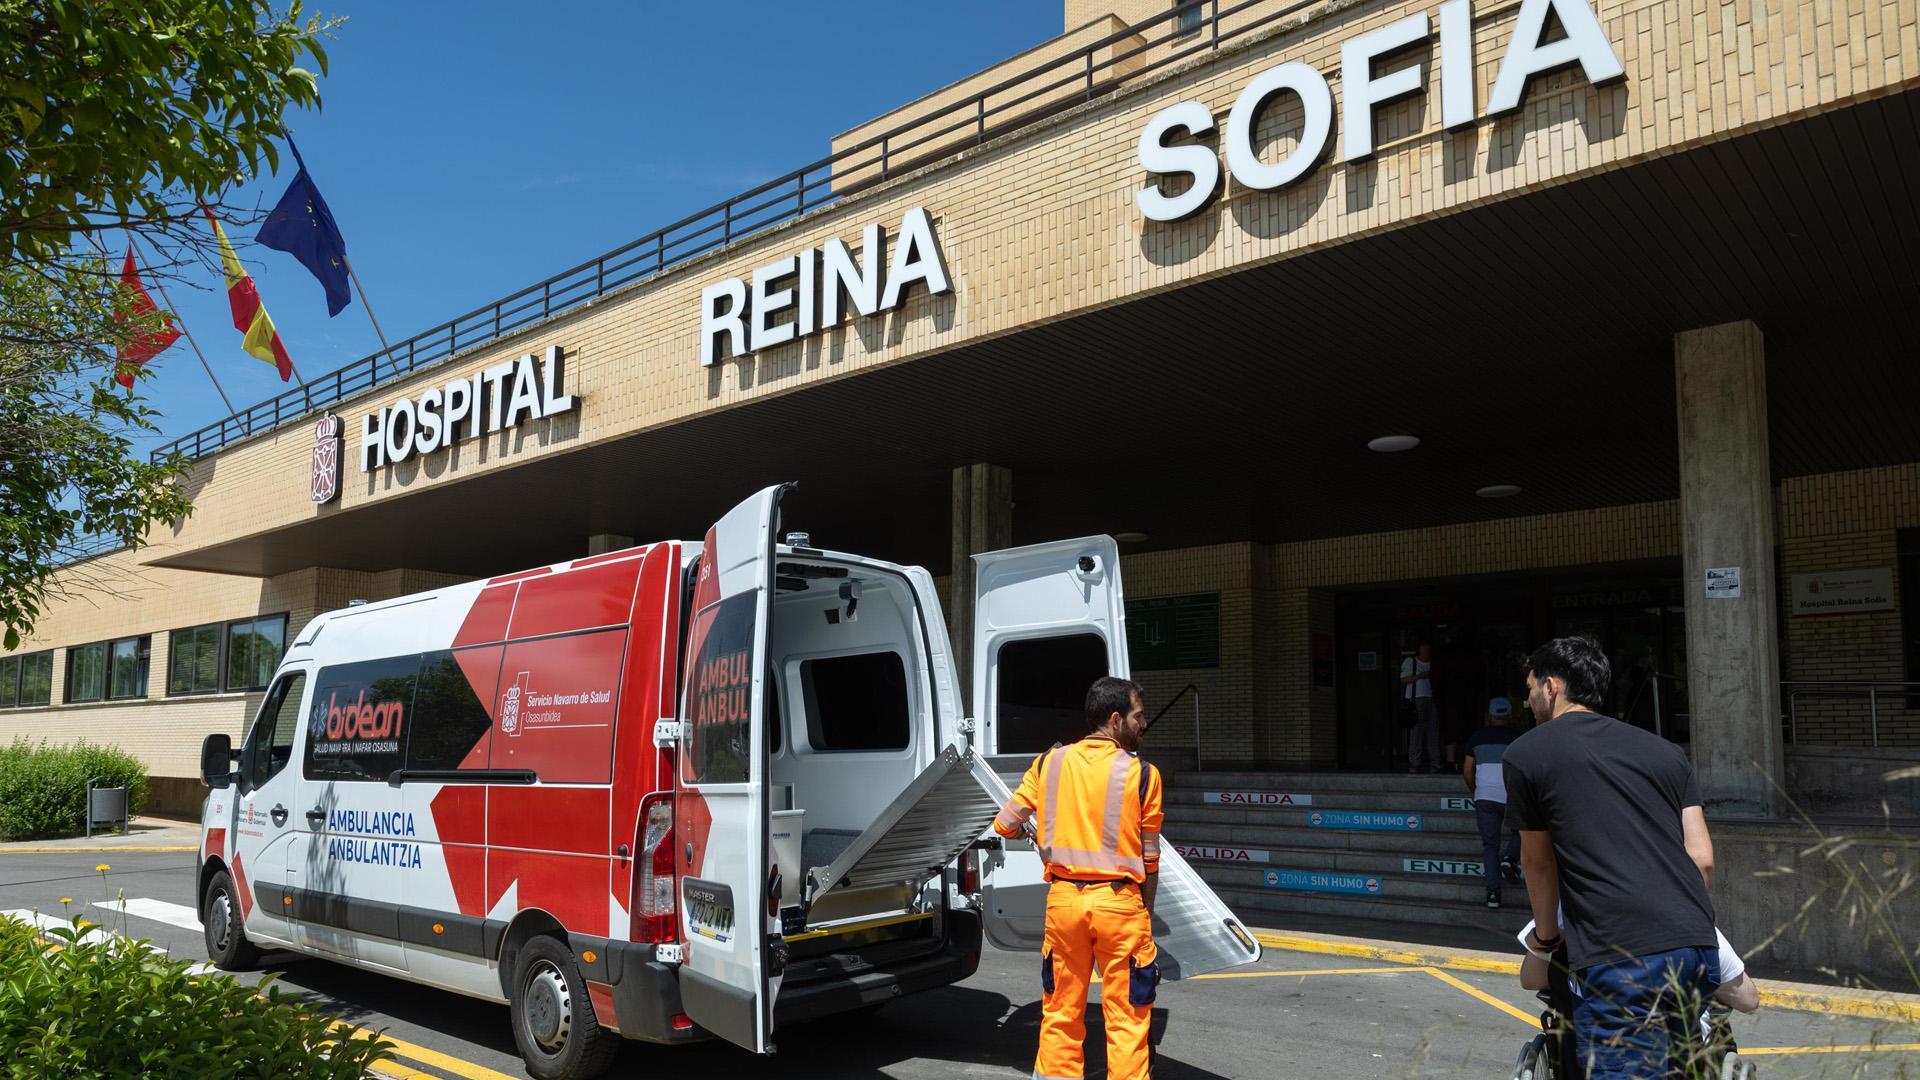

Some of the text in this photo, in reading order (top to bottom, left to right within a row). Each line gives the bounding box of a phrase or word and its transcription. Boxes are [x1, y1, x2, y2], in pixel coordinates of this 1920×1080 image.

[361, 0, 1625, 472] HOSPITAL REINA SOFIA
[1799, 599, 1835, 608] Hospital
[700, 653, 749, 692] AMBUL
[527, 689, 611, 707] Servicio Navarro de Salud
[326, 688, 403, 740] bidean
[698, 688, 748, 726] ANBUL
[525, 710, 561, 723] Osasunbidea
[354, 743, 371, 753] NAFAR
[372, 741, 398, 752] OSASUNA
[1219, 793, 1294, 805] SALIDA
[329, 809, 415, 836] AMBULANCIA
[1324, 813, 1404, 827] ZONA SIN HUMO
[328, 838, 421, 869] ANBULANTZIA
[1410, 860, 1486, 875] ENTR
[1281, 873, 1363, 889] ZONA SIN HUMO
[689, 889, 715, 903] MASTER
